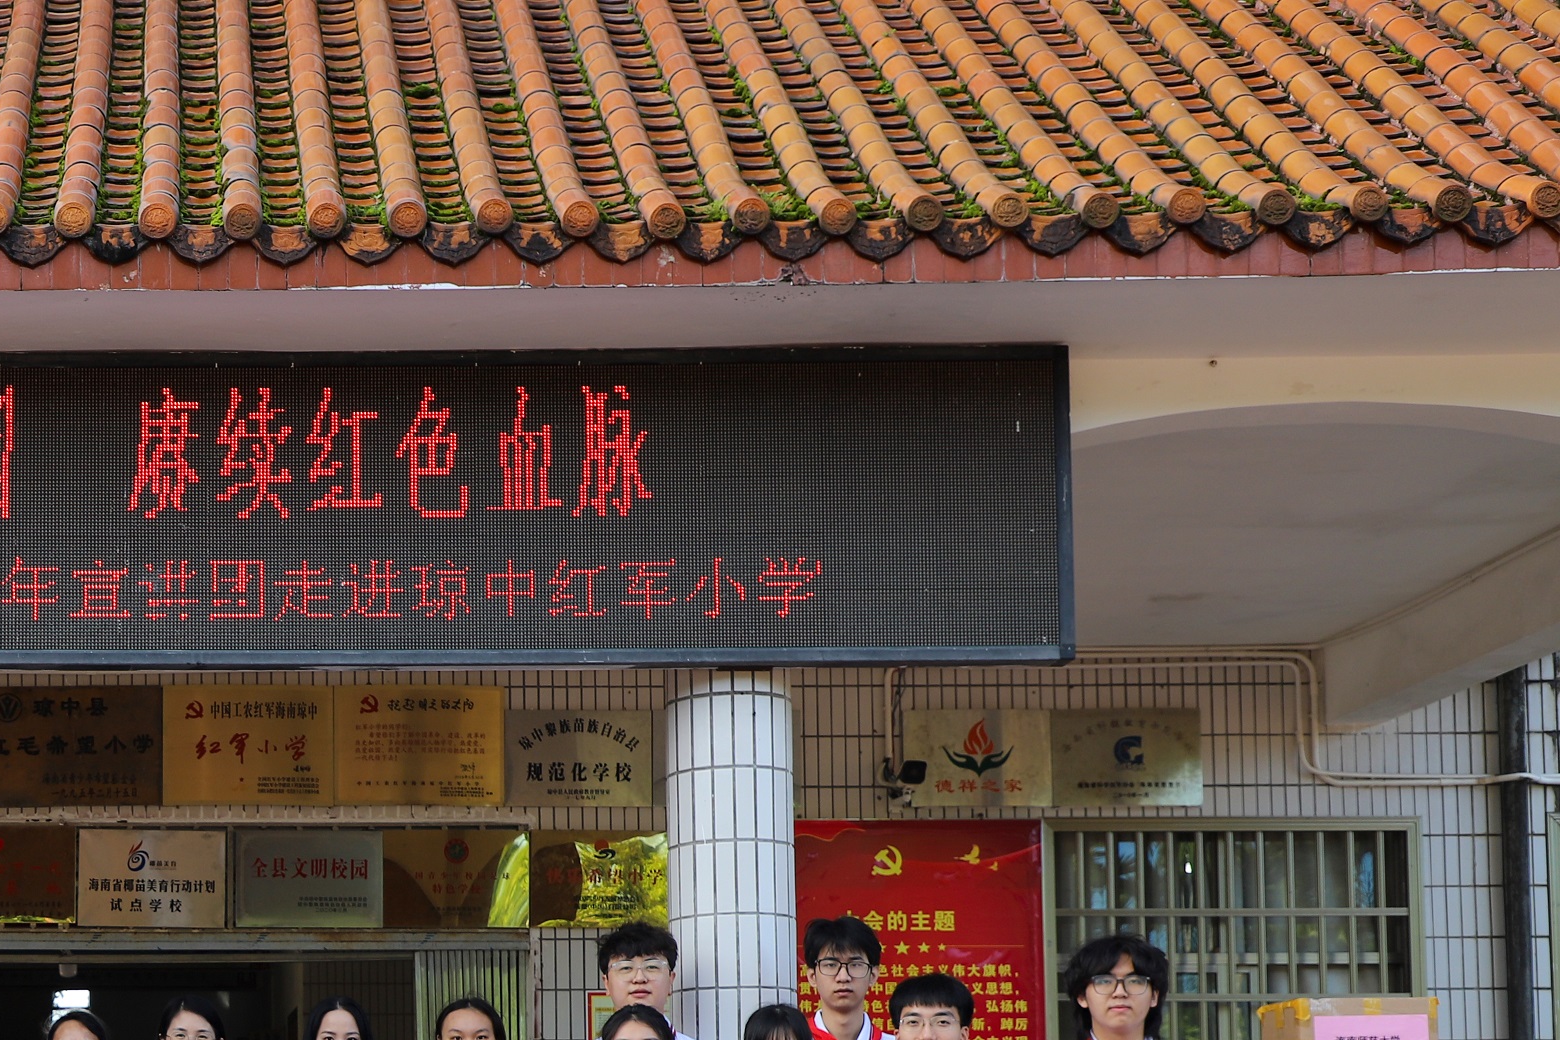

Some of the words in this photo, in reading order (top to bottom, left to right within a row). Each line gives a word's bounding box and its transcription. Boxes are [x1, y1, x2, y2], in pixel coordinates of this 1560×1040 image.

[127, 385, 653, 520] 赓续红色血脉
[32, 697, 109, 718] 琼中县
[210, 701, 318, 720] 中国工农红军海南琼中
[518, 718, 640, 752] 琼中黎族苗族自治县
[195, 732, 307, 764] 红军小学
[526, 762, 632, 782] 规范化学校
[934, 778, 1024, 794] 德祥之家
[251, 857, 369, 880] 全县文明校园
[88, 878, 216, 893] 海南省椰苗美育行动计划
[110, 898, 183, 912] 试点学校
